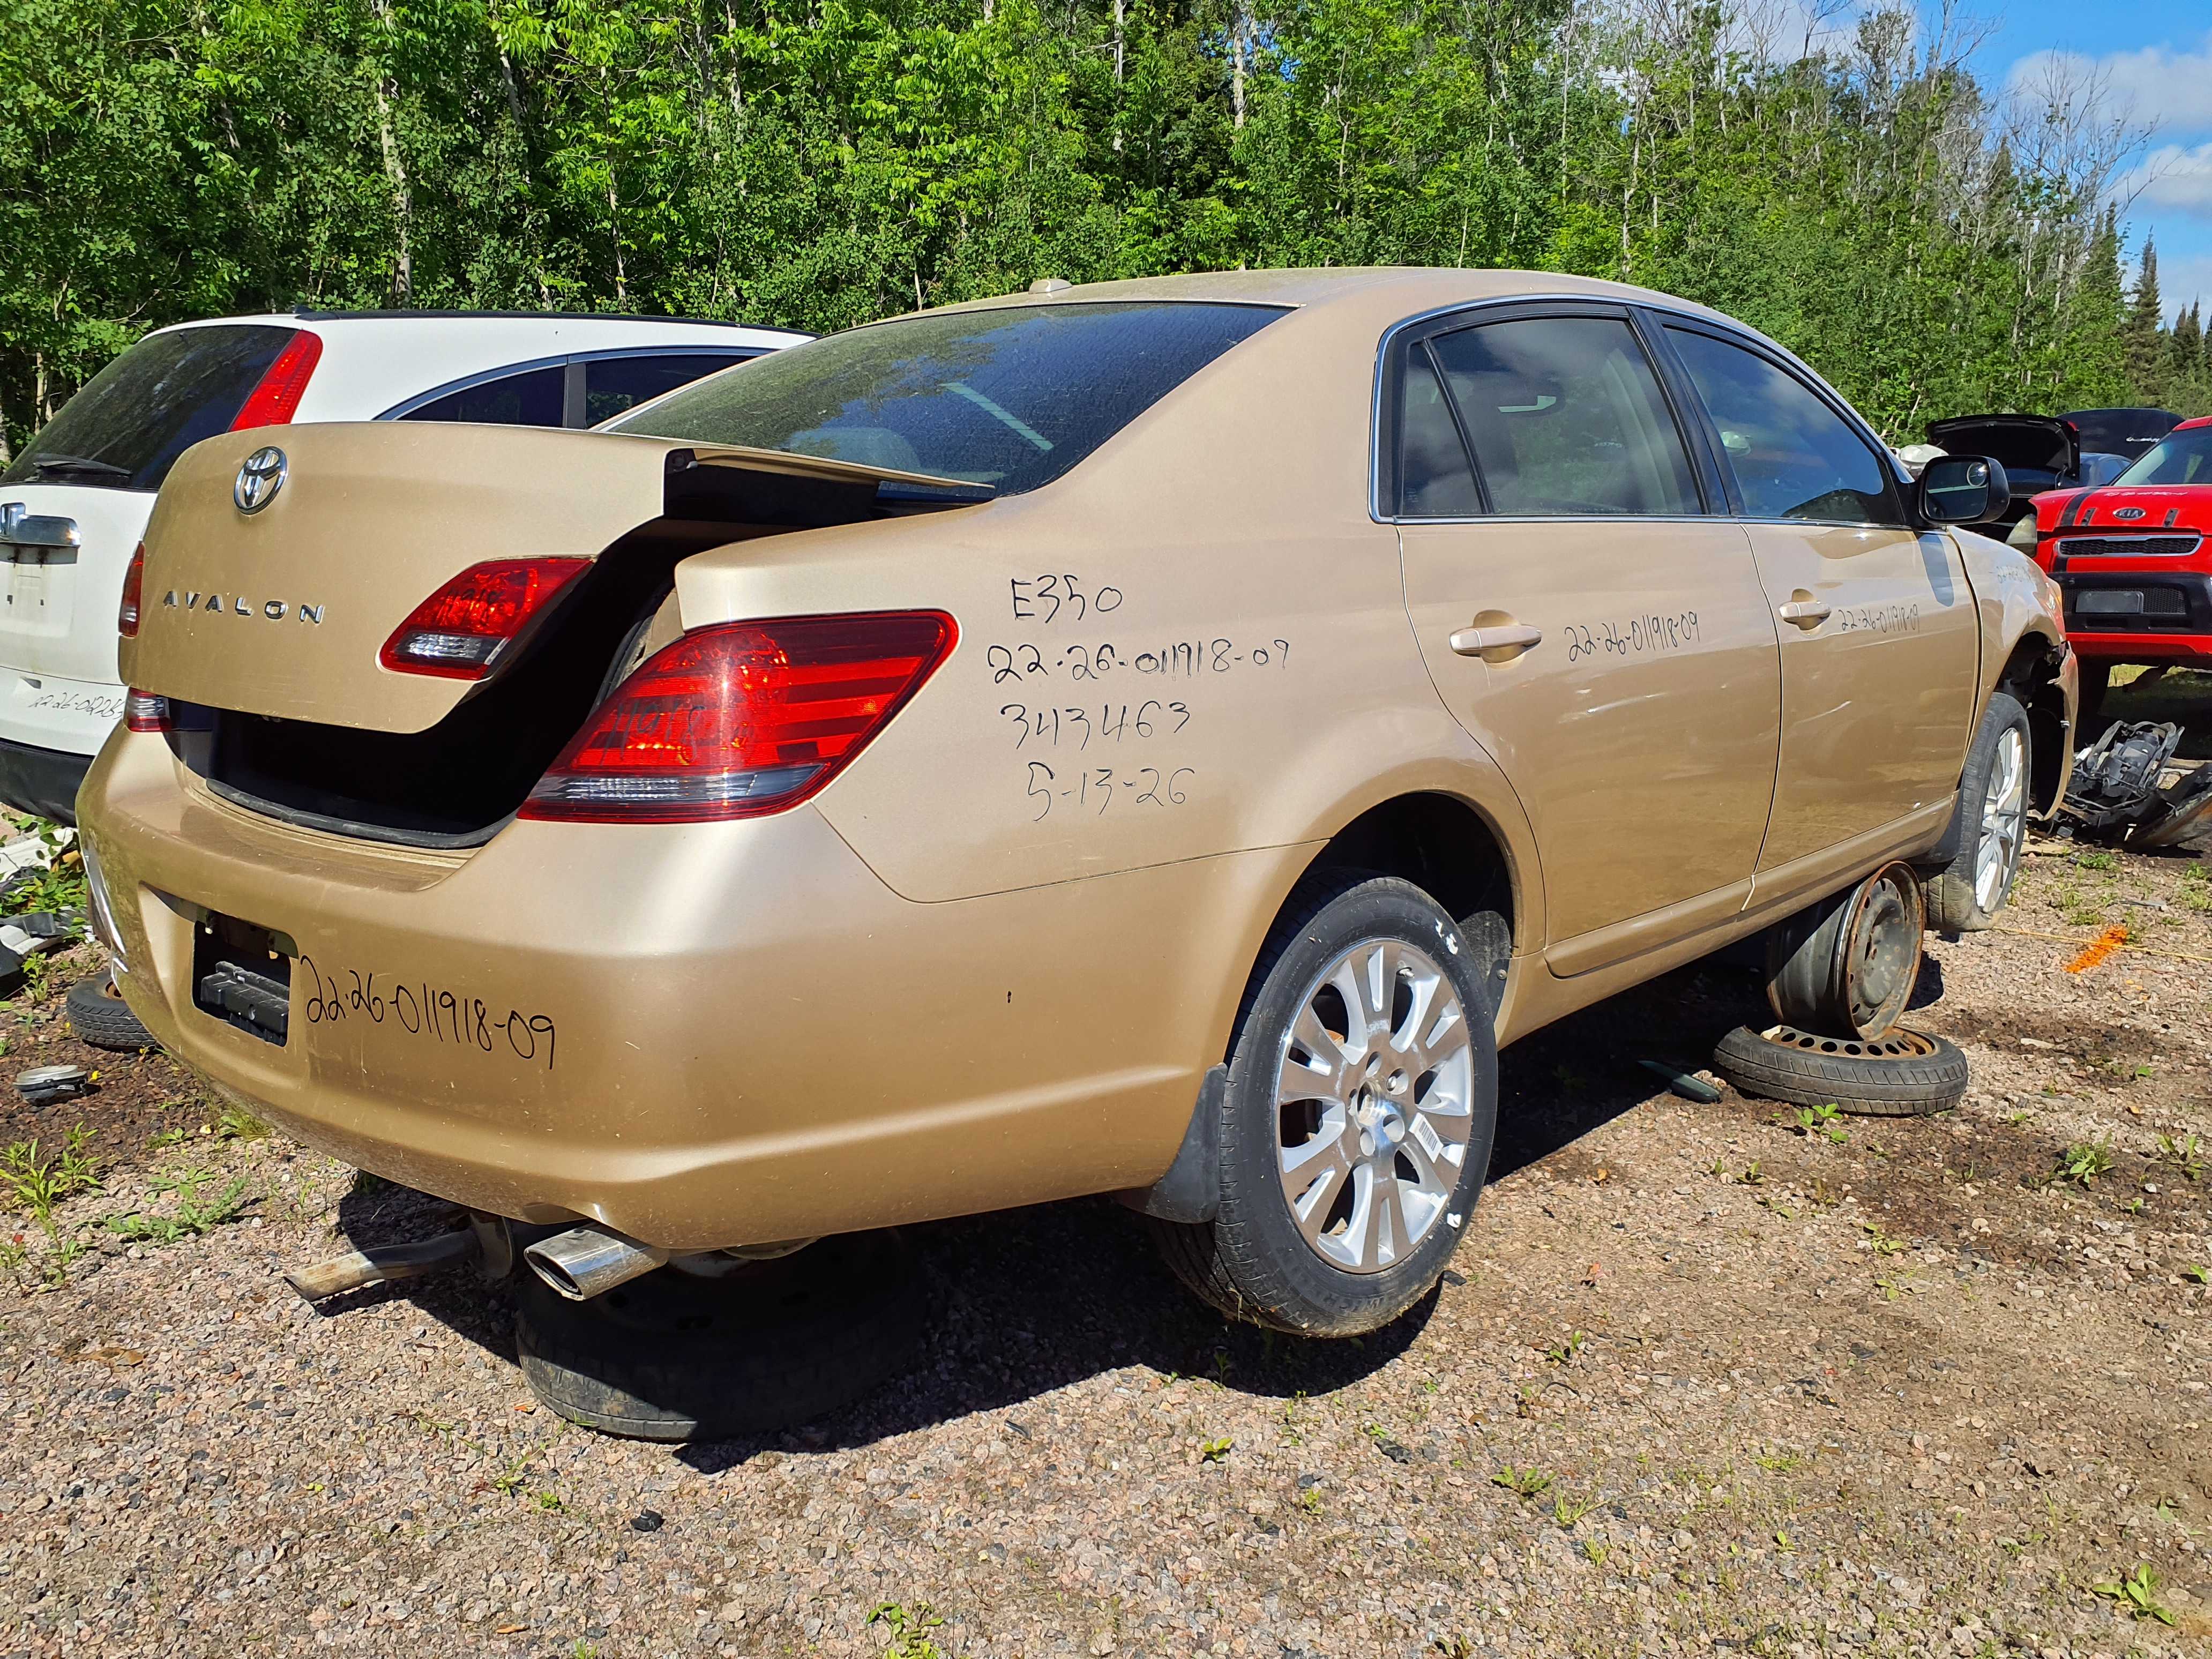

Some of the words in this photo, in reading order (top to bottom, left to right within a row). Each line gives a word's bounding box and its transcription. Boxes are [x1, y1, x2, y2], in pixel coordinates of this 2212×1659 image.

[162, 590, 325, 625] AVALON
[1011, 574, 1123, 624] E350
[1000, 700, 1191, 751] 343463
[1027, 761, 1195, 821] 5-13-26
